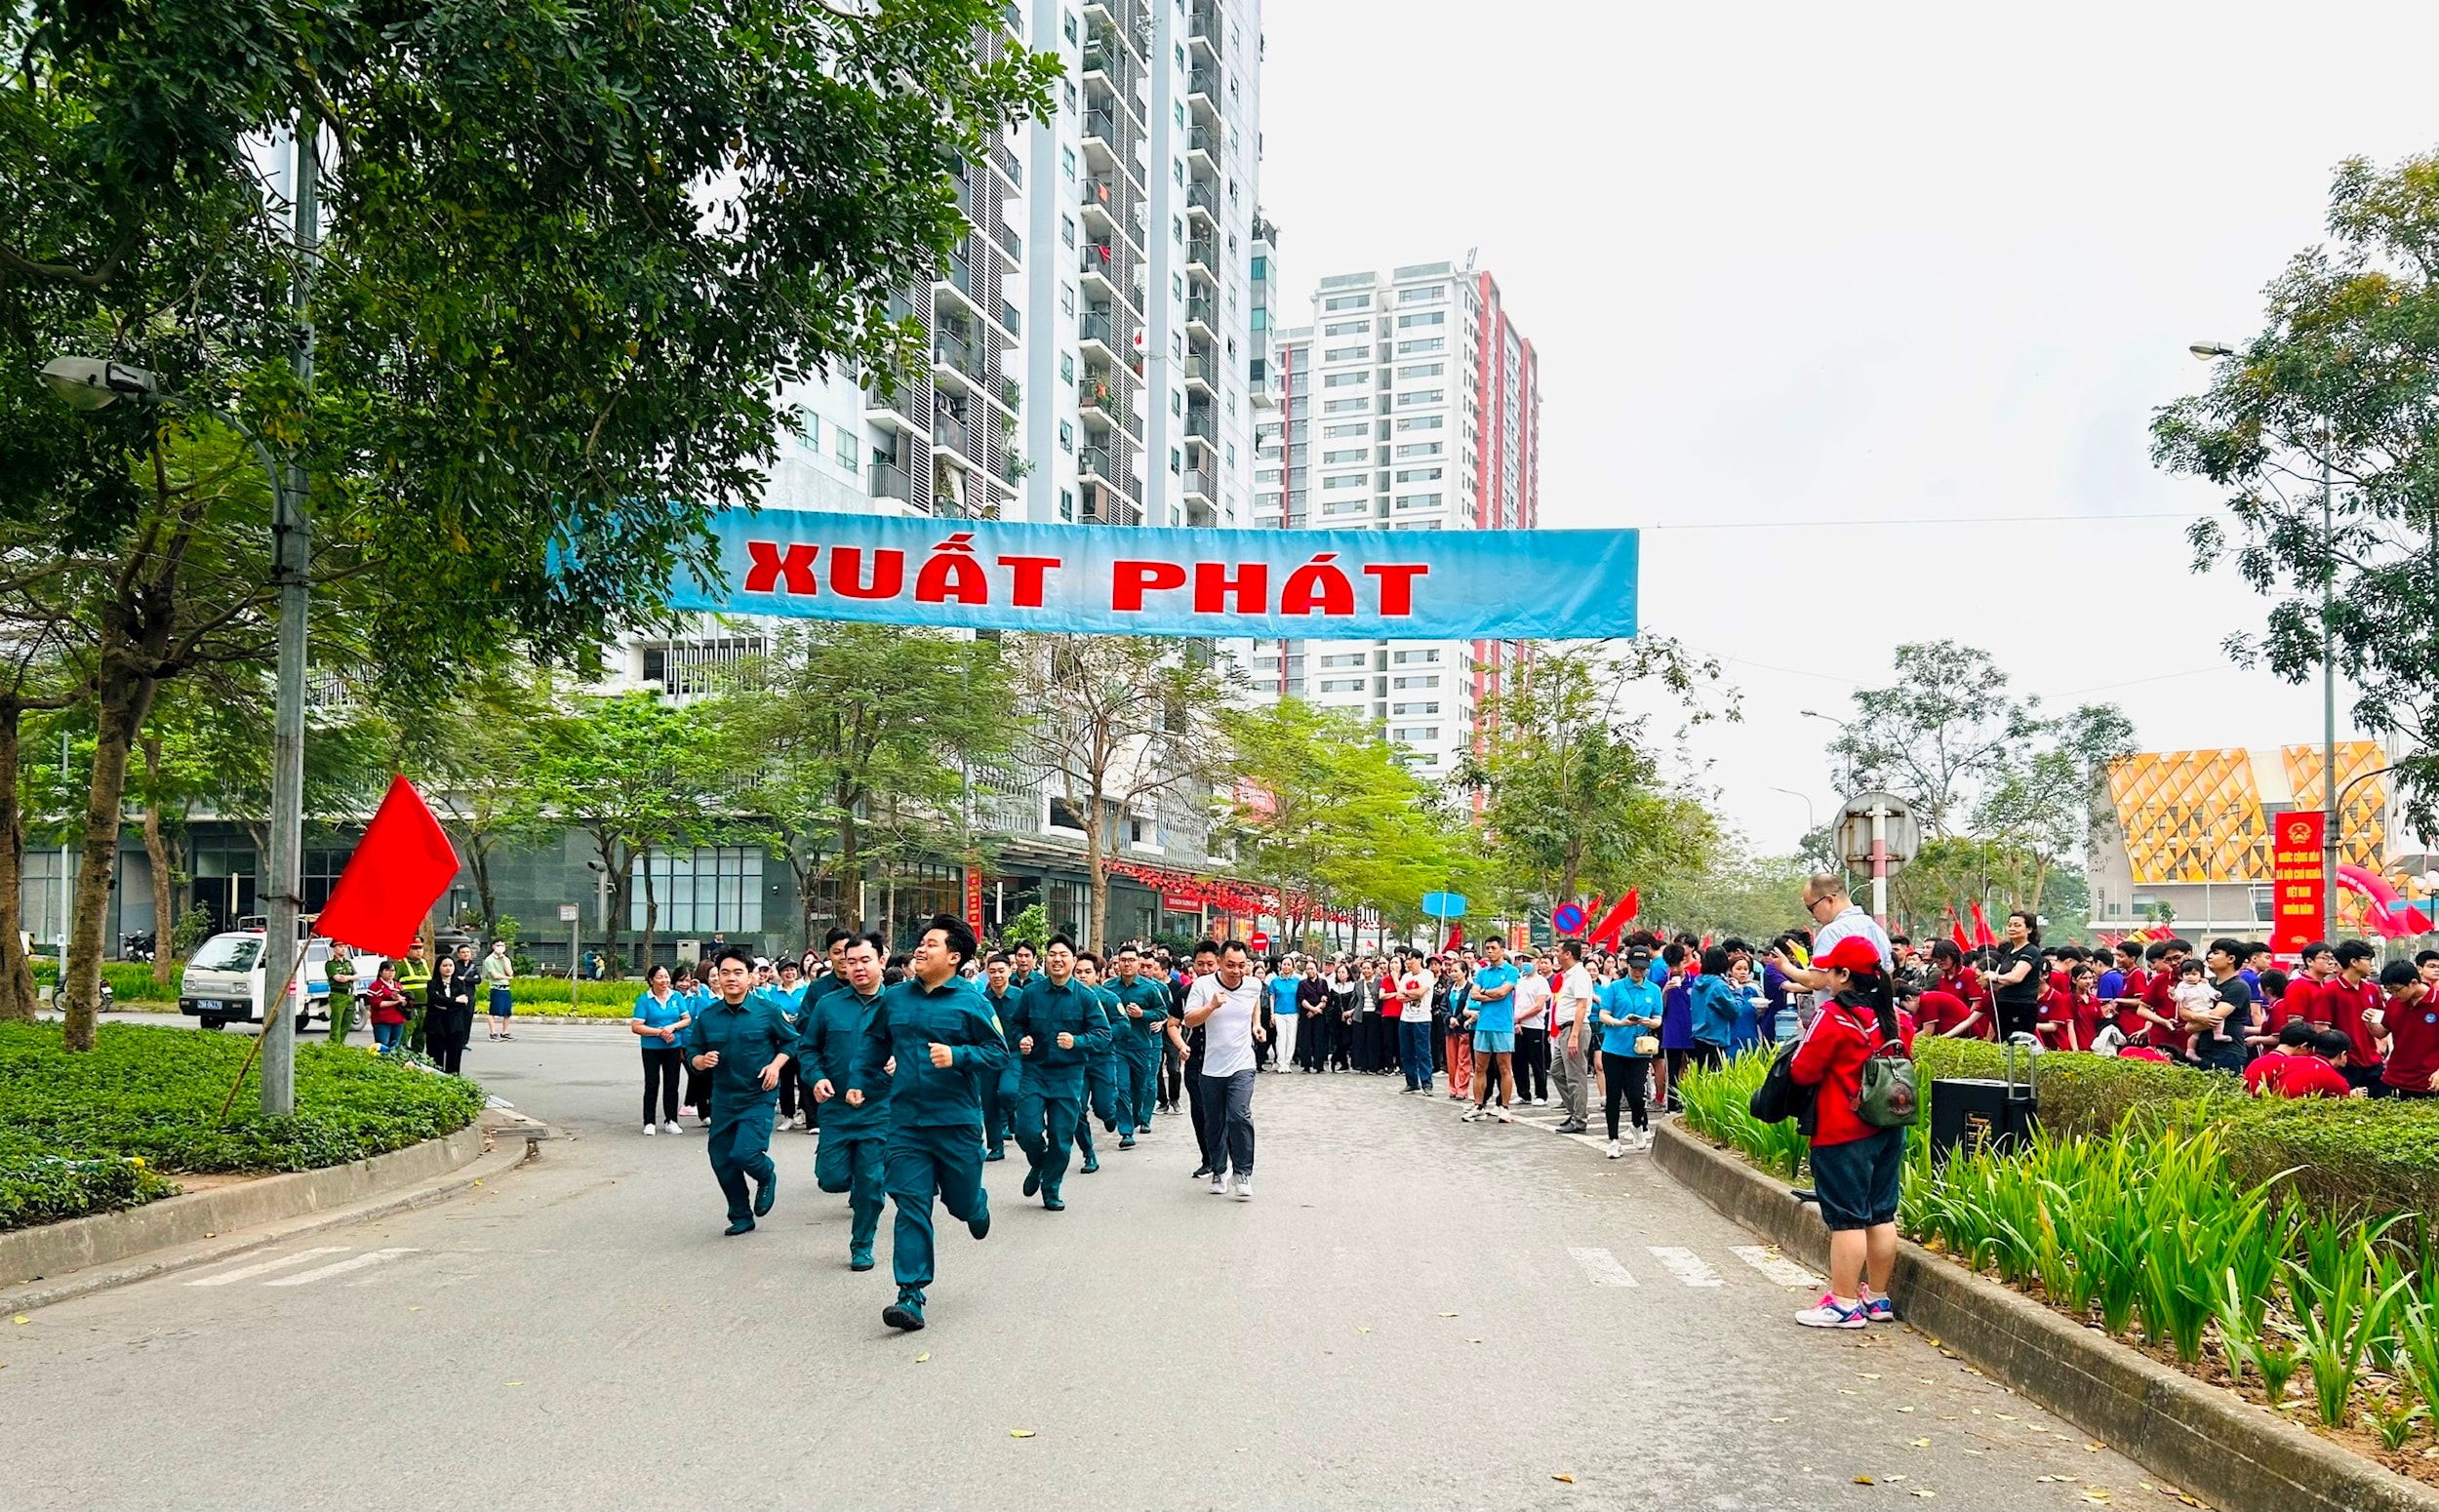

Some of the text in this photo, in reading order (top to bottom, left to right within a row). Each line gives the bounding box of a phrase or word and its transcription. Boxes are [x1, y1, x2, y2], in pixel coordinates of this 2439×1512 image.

[745, 533, 1429, 617] XUẤT PHÁT
[2286, 884, 2311, 899] VIỆT NAM
